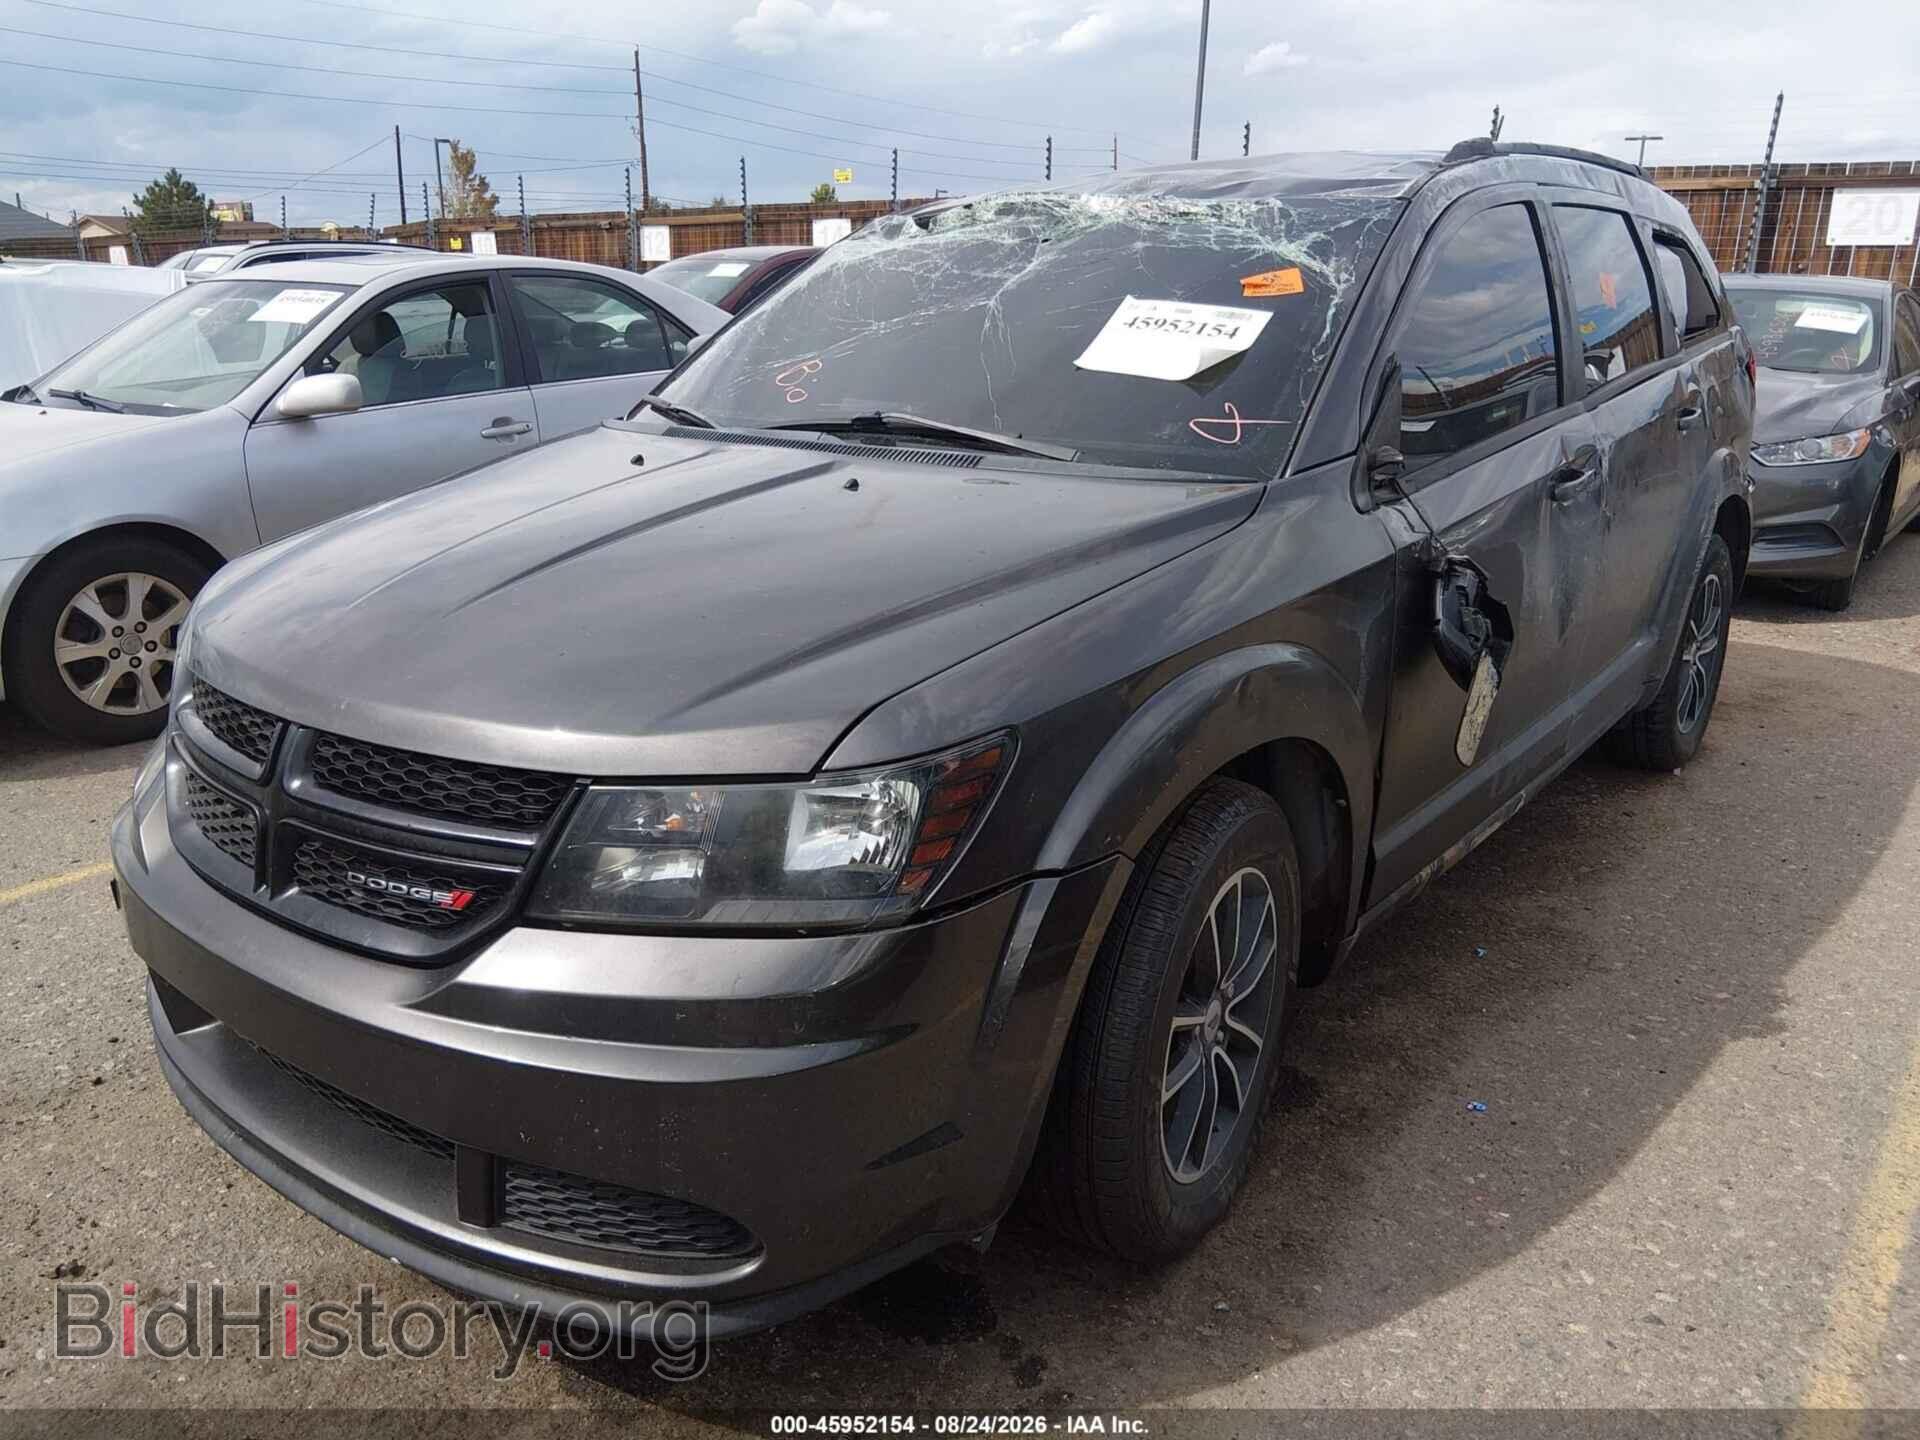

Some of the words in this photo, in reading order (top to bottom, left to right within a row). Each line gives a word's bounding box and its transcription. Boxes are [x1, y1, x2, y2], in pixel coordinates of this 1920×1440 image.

[1841, 196, 1903, 235] 20
[1123, 315, 1240, 340] 45952154
[347, 871, 454, 905] DODGE
